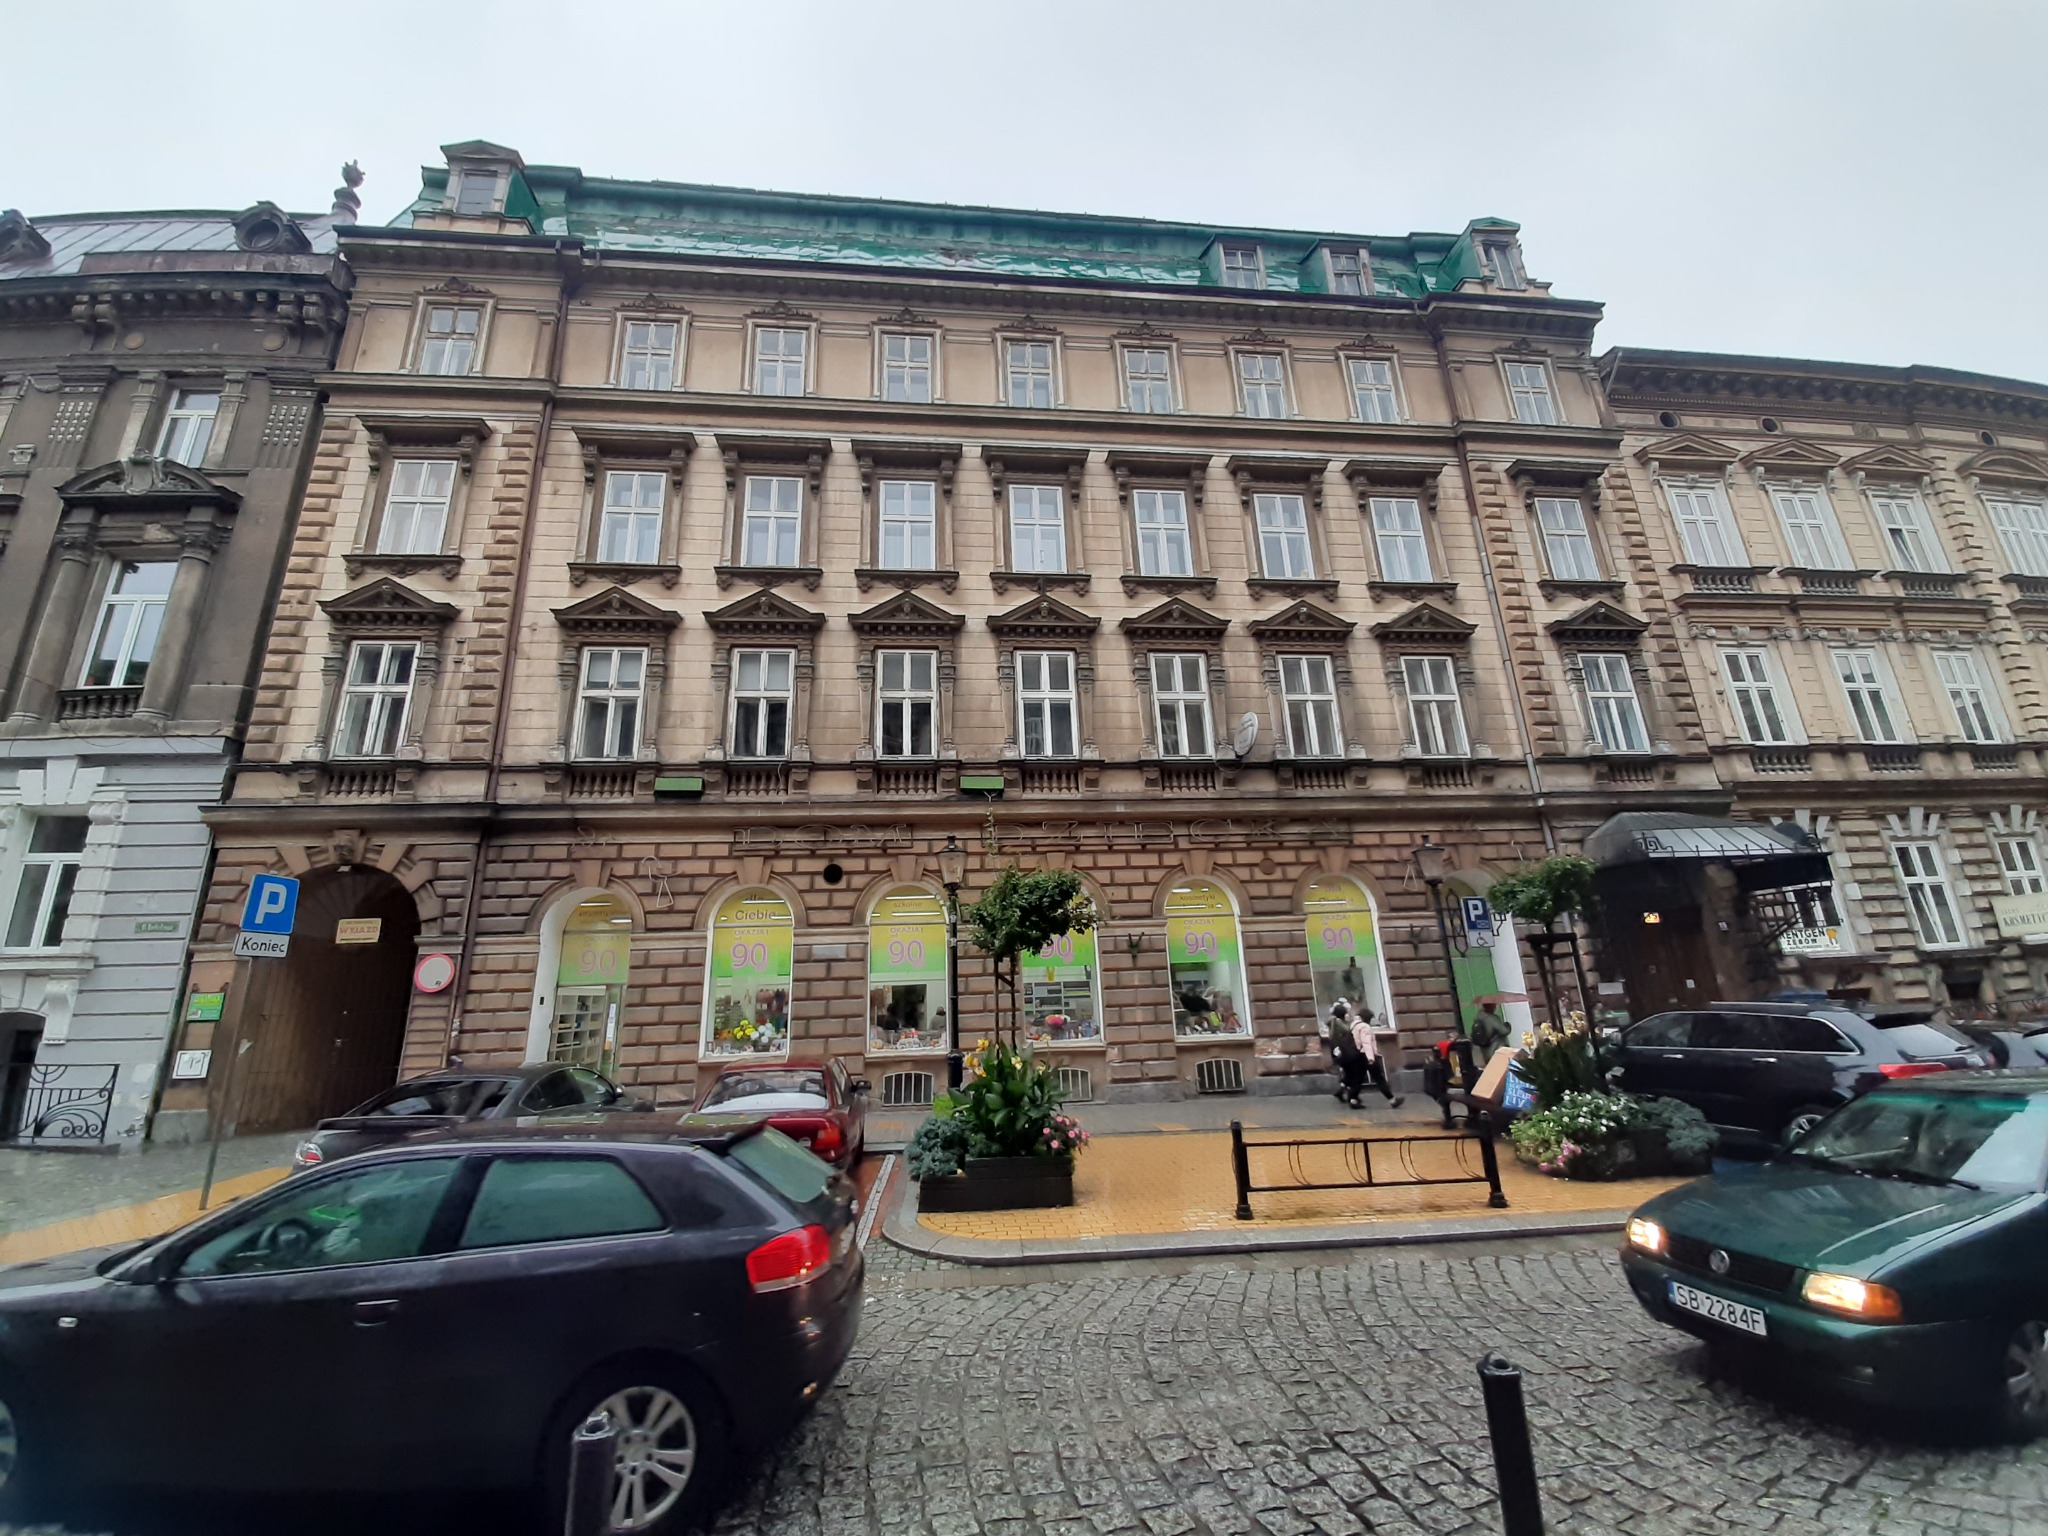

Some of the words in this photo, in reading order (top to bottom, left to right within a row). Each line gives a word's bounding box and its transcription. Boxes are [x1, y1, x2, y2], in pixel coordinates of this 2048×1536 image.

[255, 882, 287, 924] P
[735, 909, 776, 920] Ciebie
[1467, 899, 1483, 921] P
[241, 937, 285, 953] Koniec
[1184, 931, 1216, 956] 90
[1322, 926, 1354, 951] 90
[578, 948, 617, 975] 90
[731, 942, 767, 969] 90
[888, 939, 924, 966] 90
[1677, 1286, 1699, 1310] SB
[1705, 1296, 1760, 1331] 2284F
